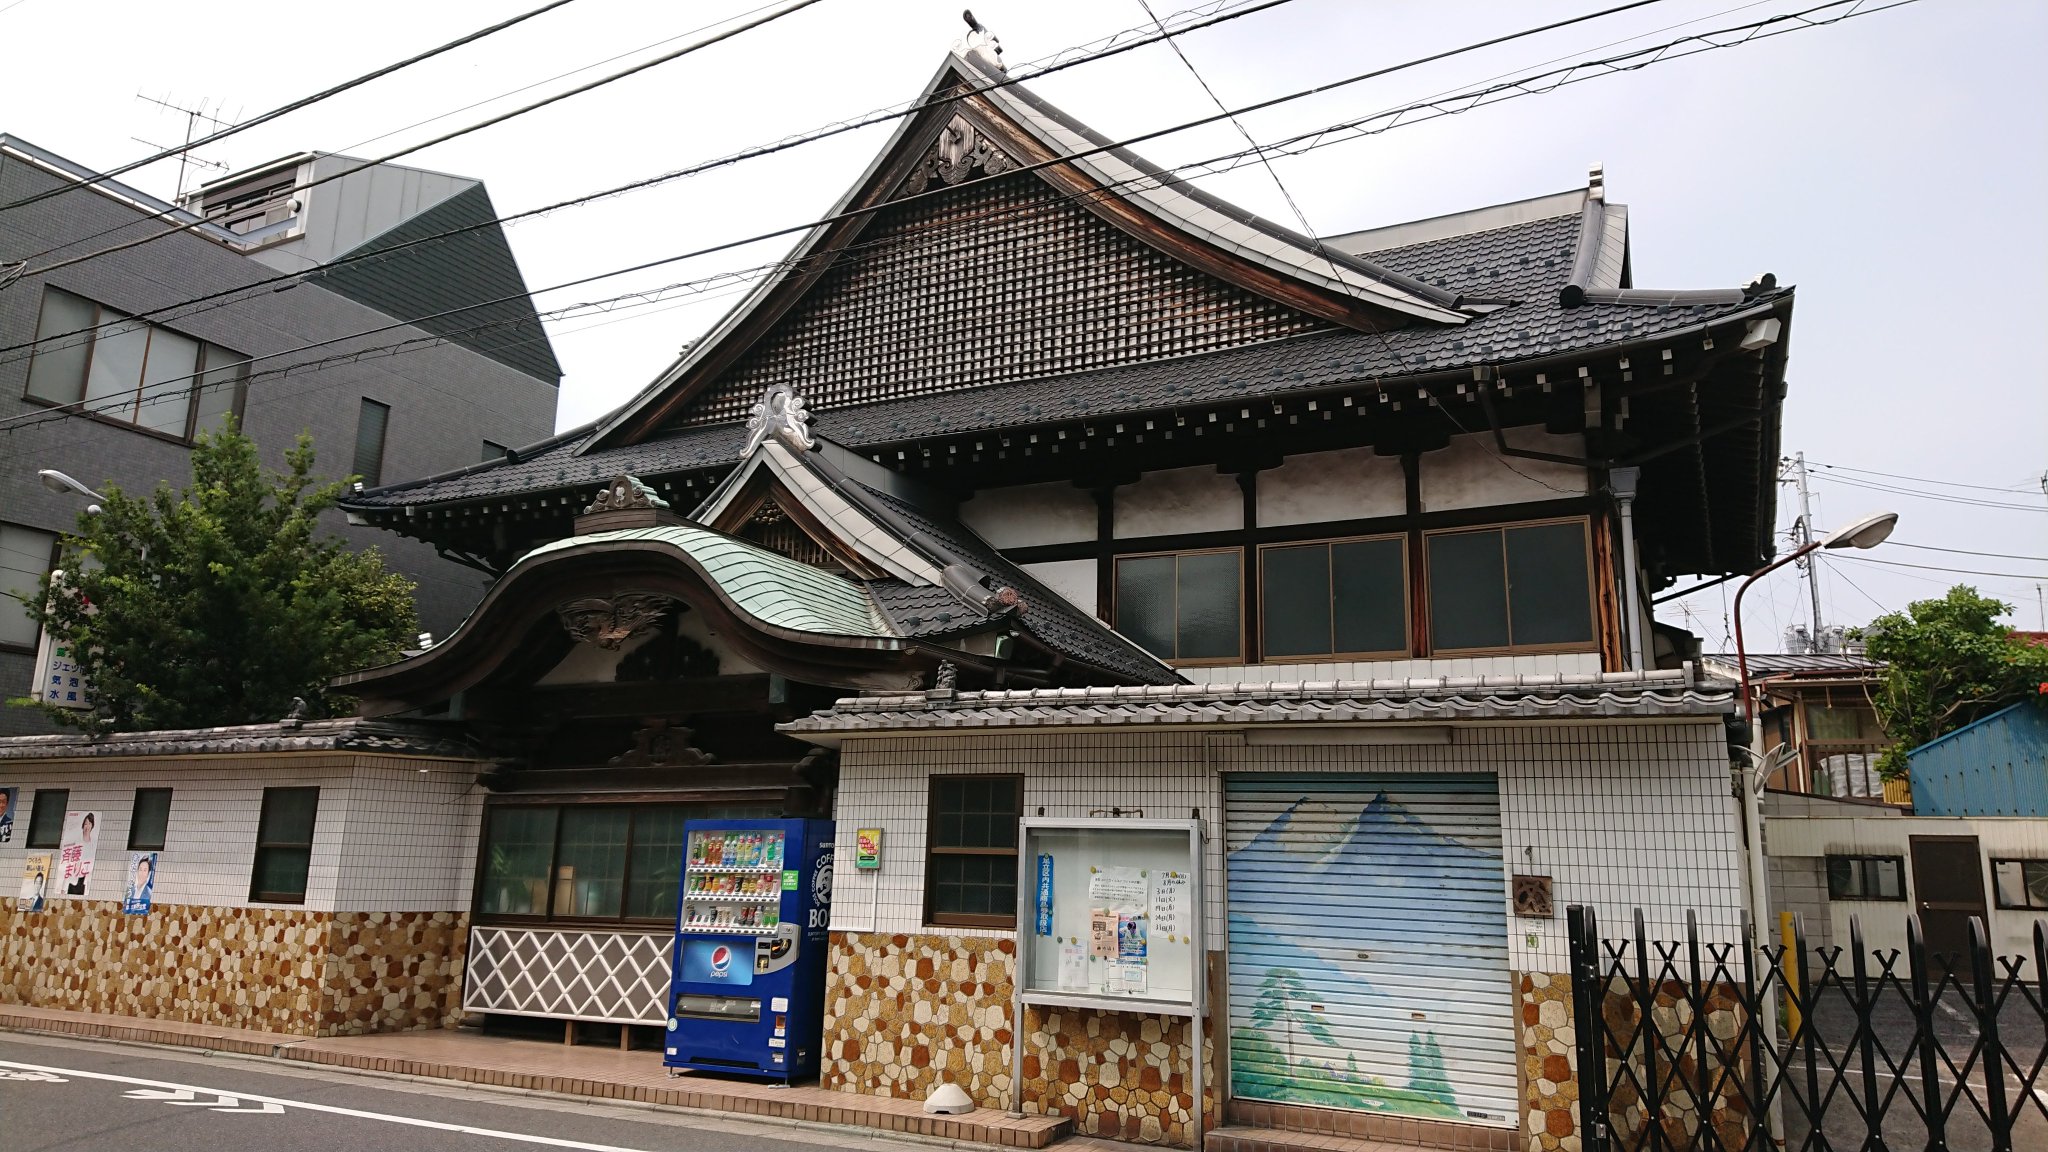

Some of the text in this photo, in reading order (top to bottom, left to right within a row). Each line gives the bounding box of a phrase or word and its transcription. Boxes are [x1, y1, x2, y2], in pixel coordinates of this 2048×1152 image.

[816, 853, 834, 869] COFF
[808, 908, 830, 928] BO
[709, 970, 728, 978] pepsi
